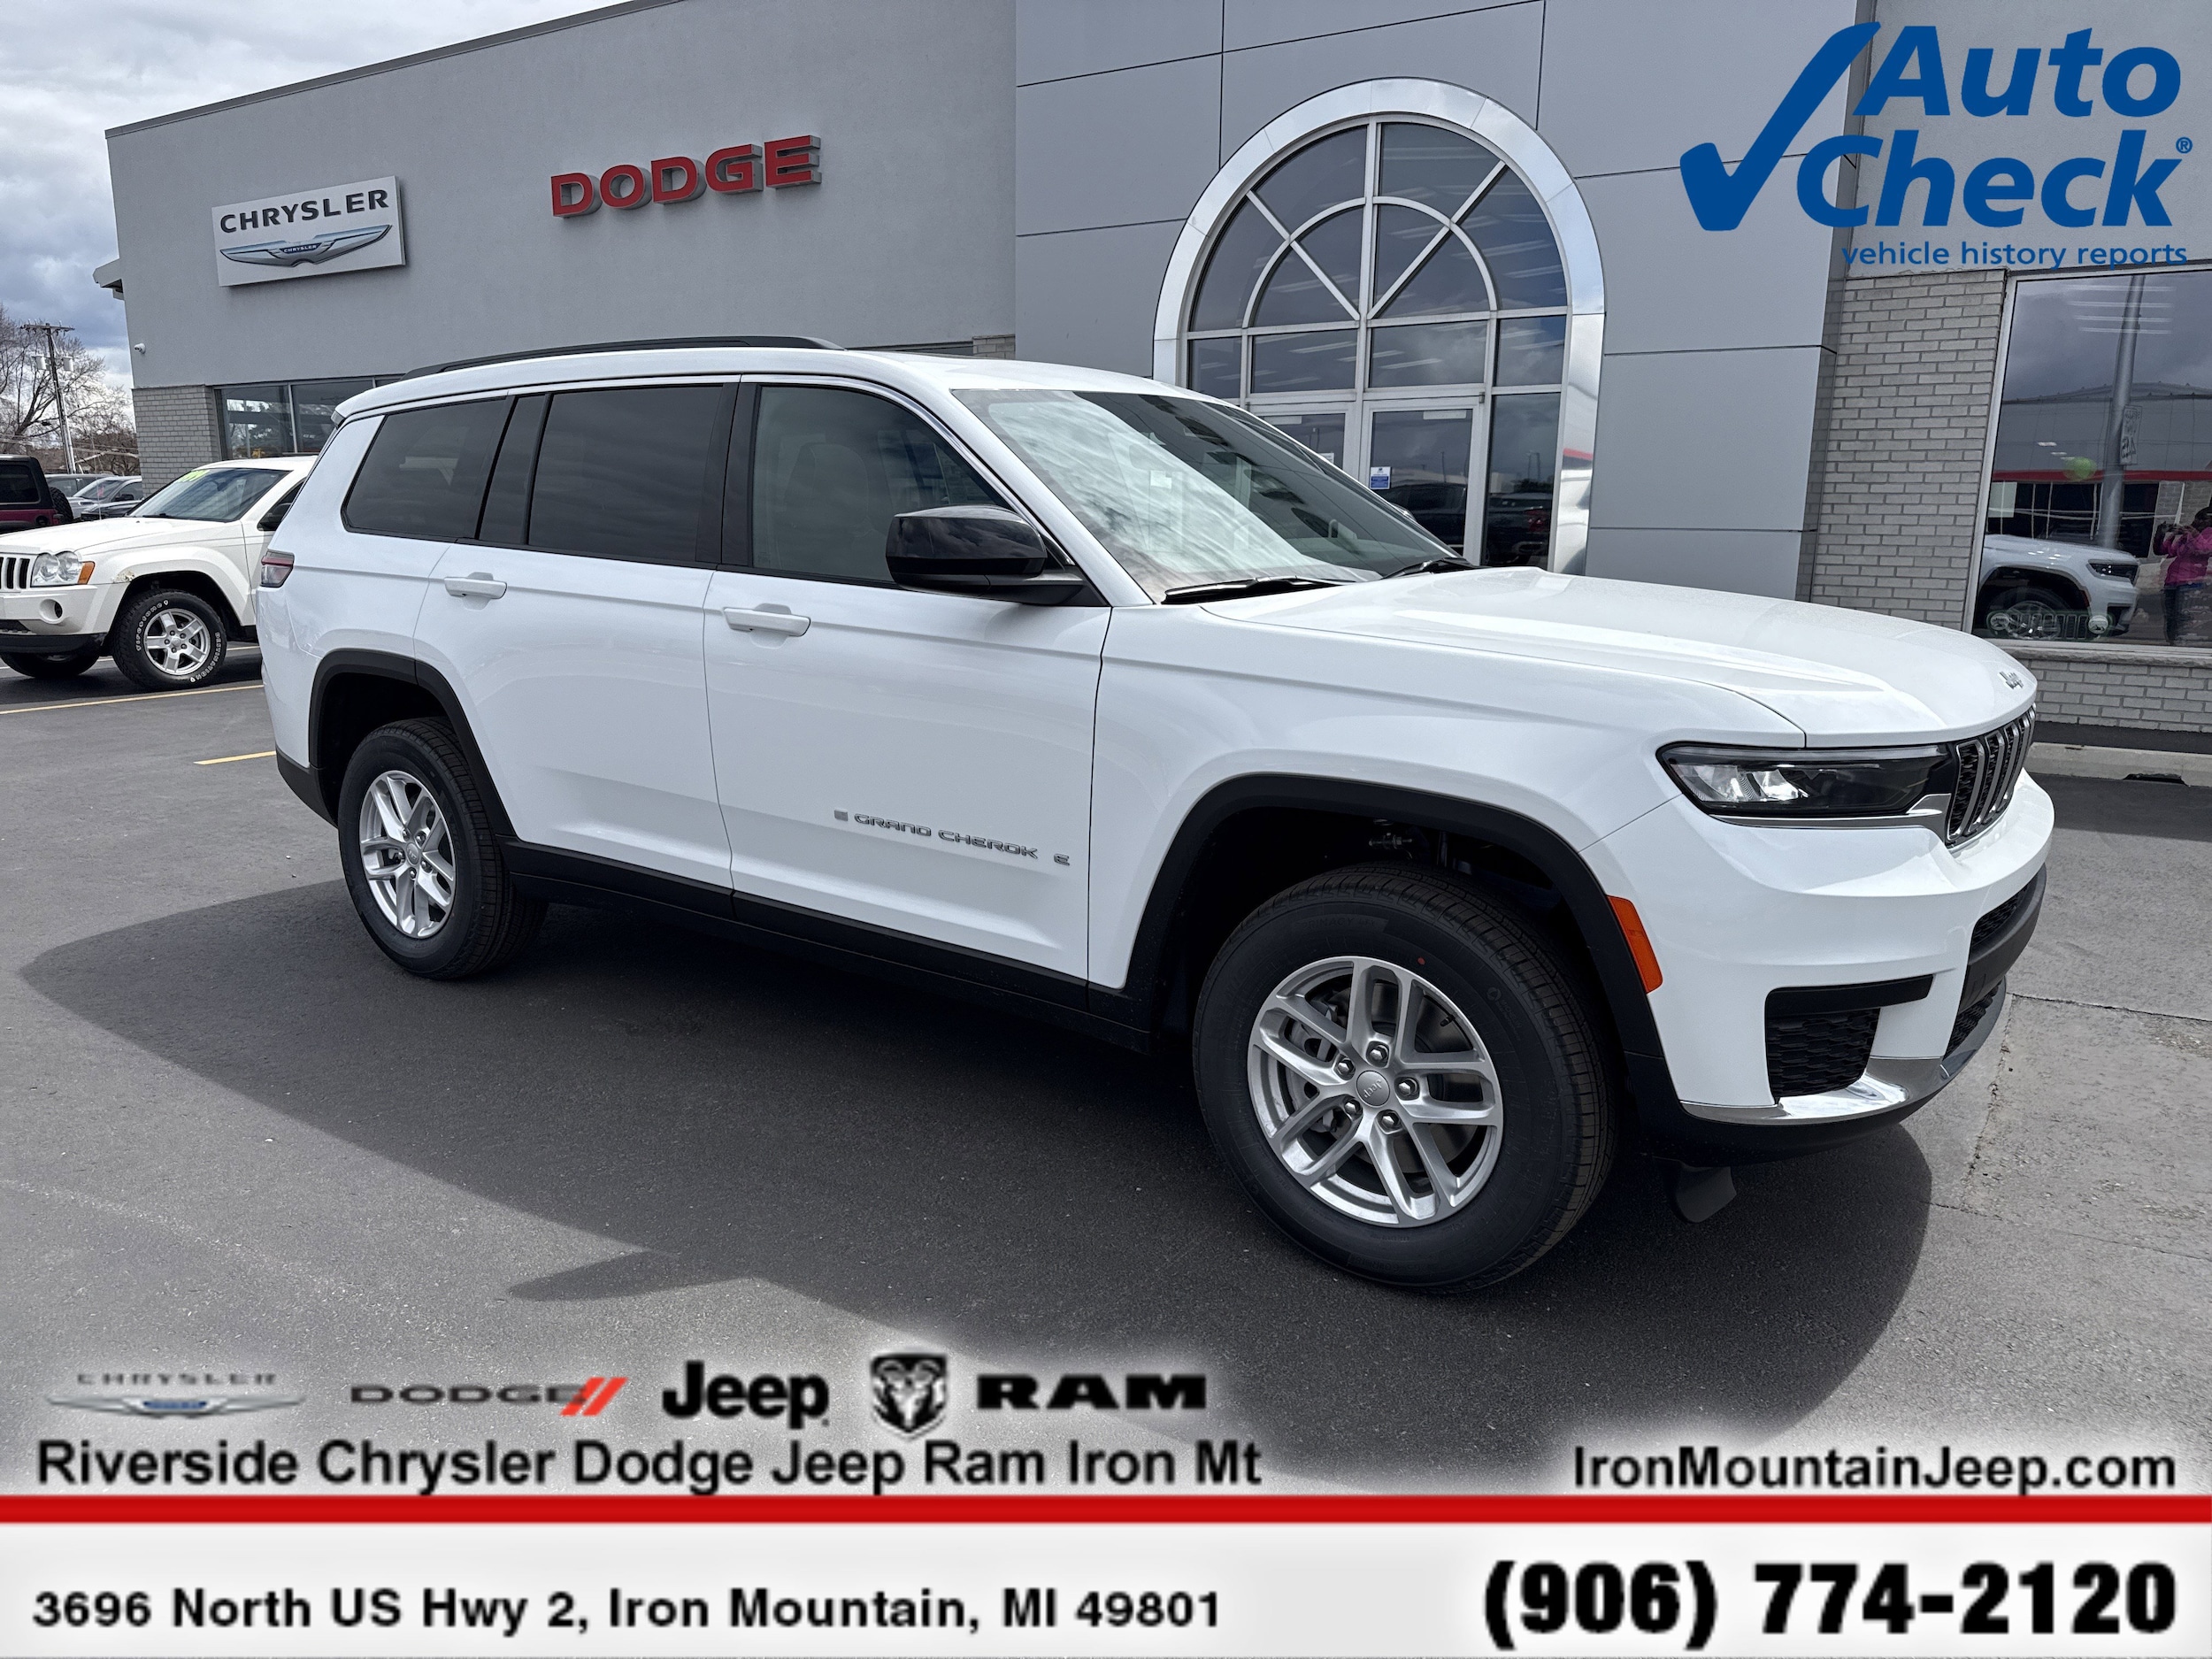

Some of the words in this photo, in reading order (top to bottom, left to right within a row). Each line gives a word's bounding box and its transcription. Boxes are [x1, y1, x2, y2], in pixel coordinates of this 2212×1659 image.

[550, 134, 821, 219] DODGE
[220, 188, 389, 234] CHRYSLER
[854, 812, 932, 837] GRAND
